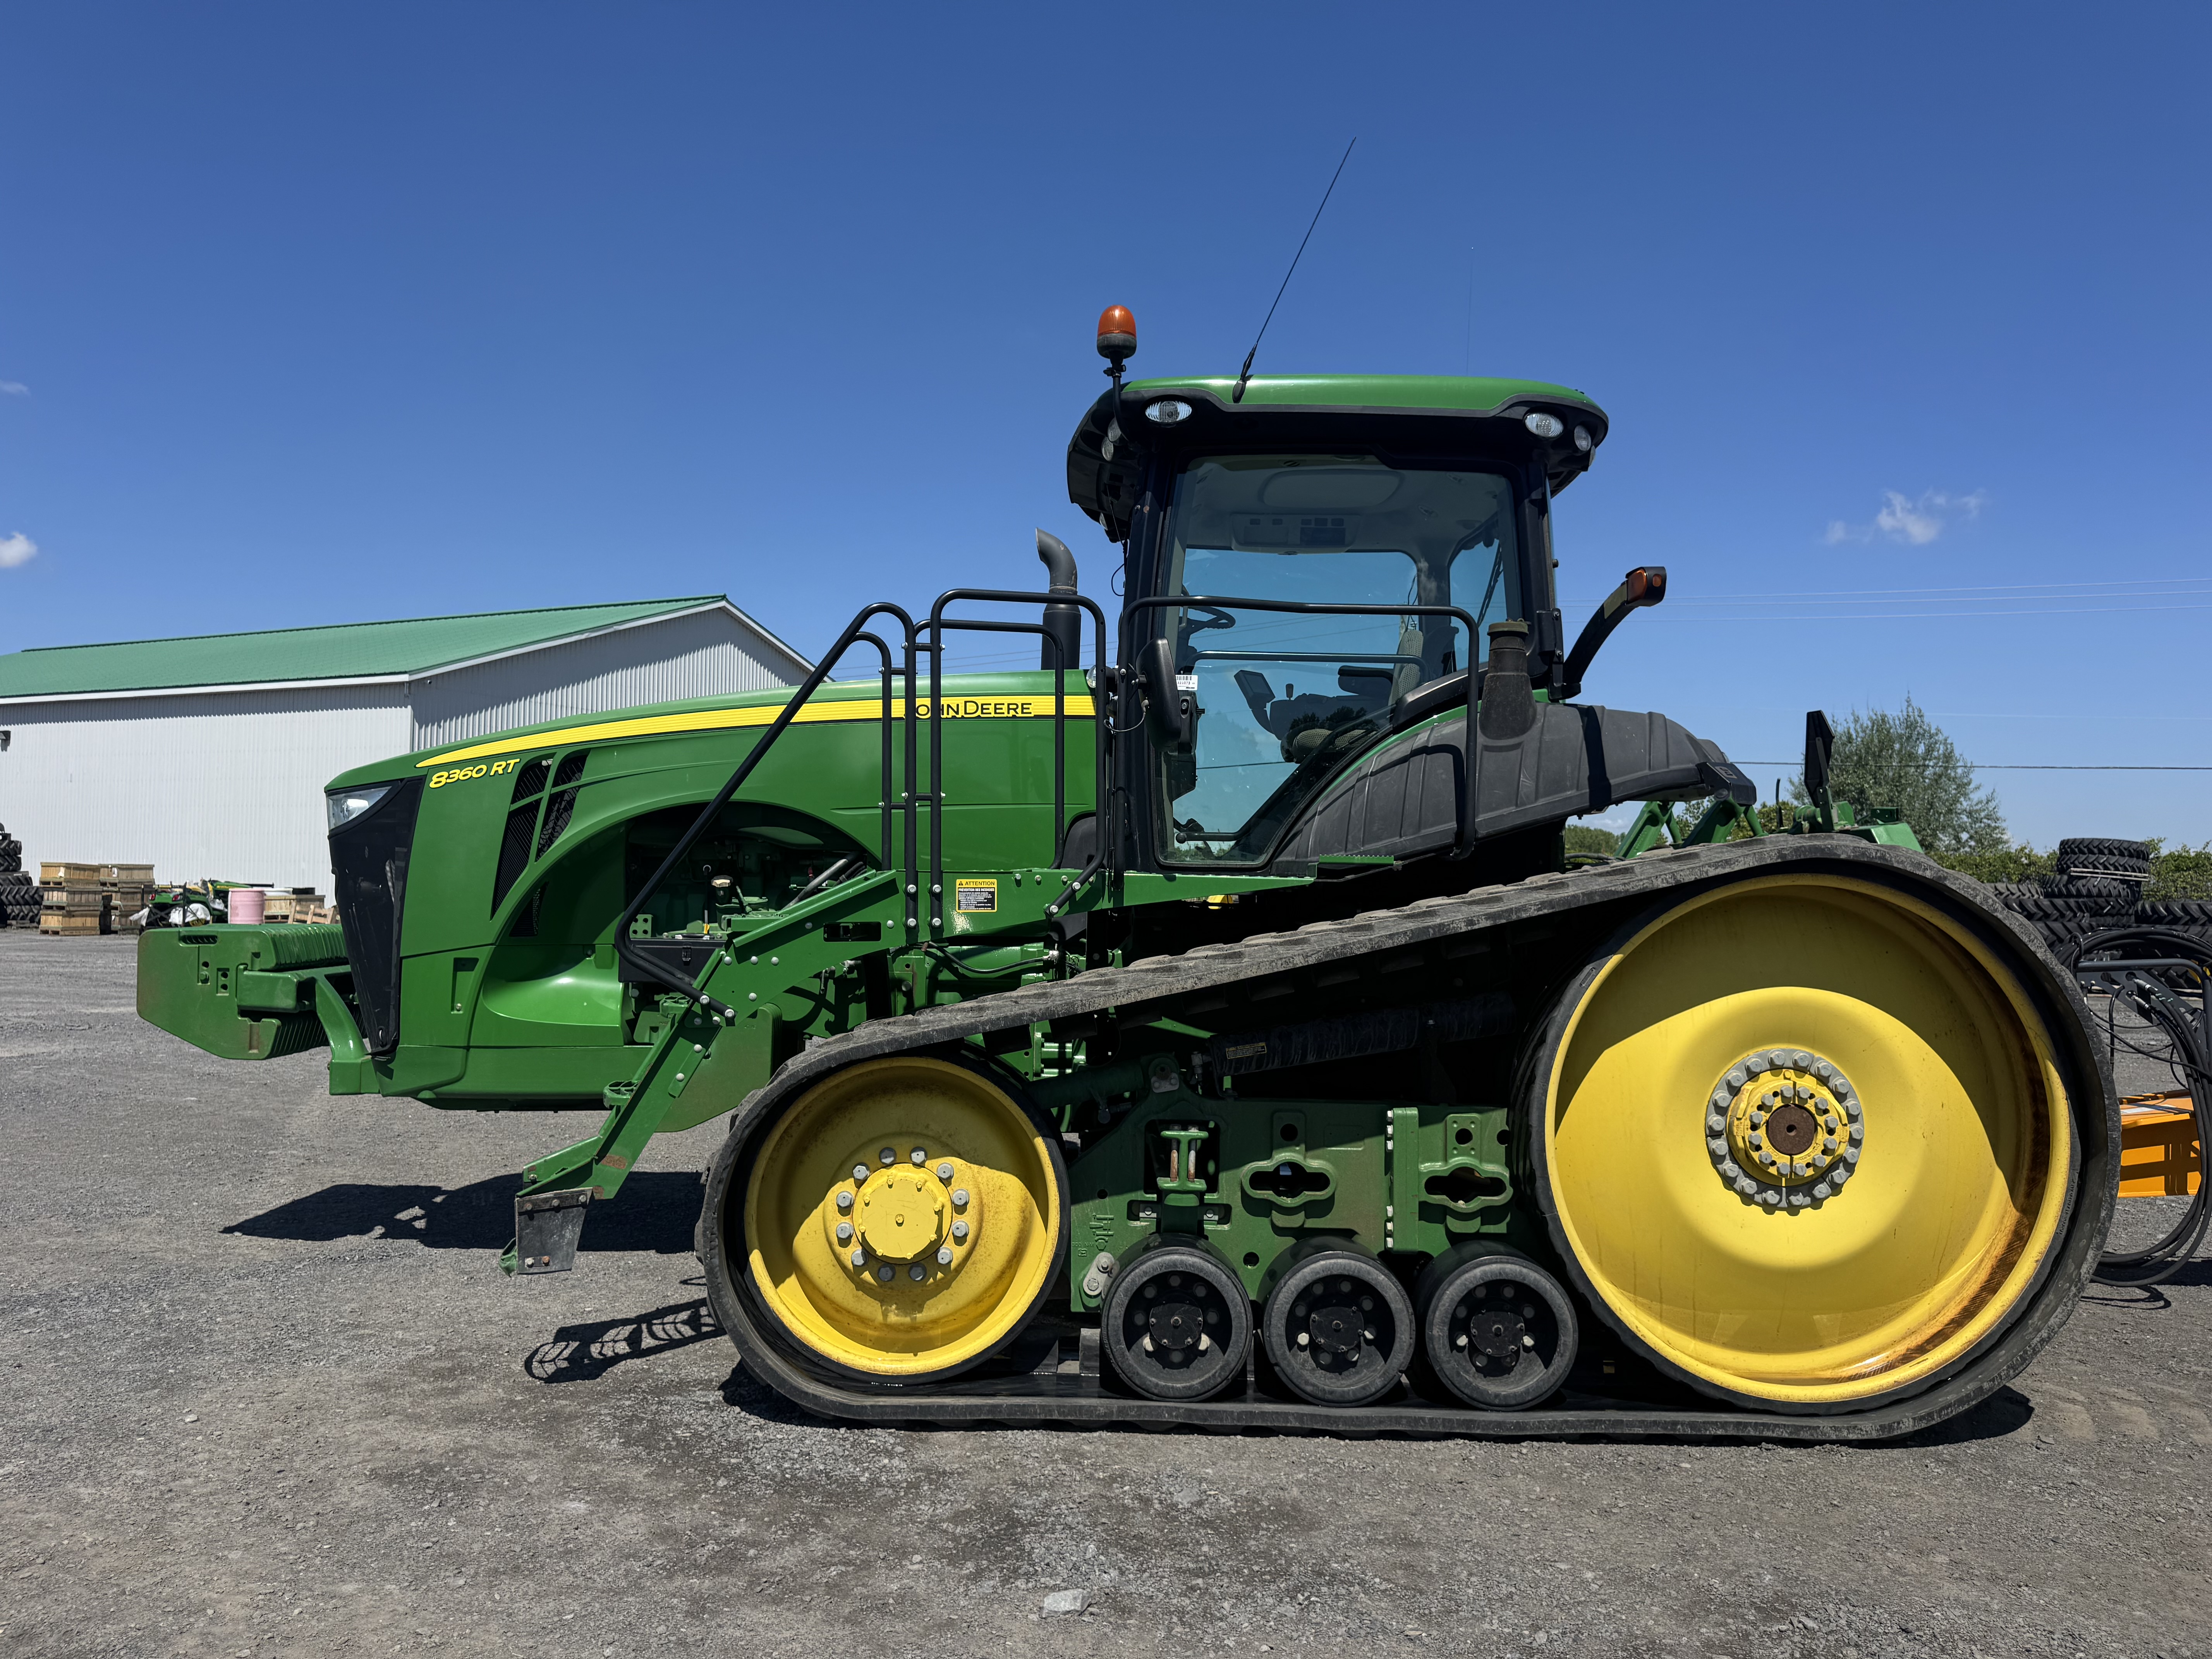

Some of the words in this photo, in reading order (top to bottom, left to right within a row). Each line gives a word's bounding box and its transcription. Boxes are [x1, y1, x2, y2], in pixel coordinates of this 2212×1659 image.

[907, 704, 959, 716] ON
[964, 701, 1032, 714] DEERE
[429, 764, 487, 788] 8360
[490, 758, 520, 776] RT
